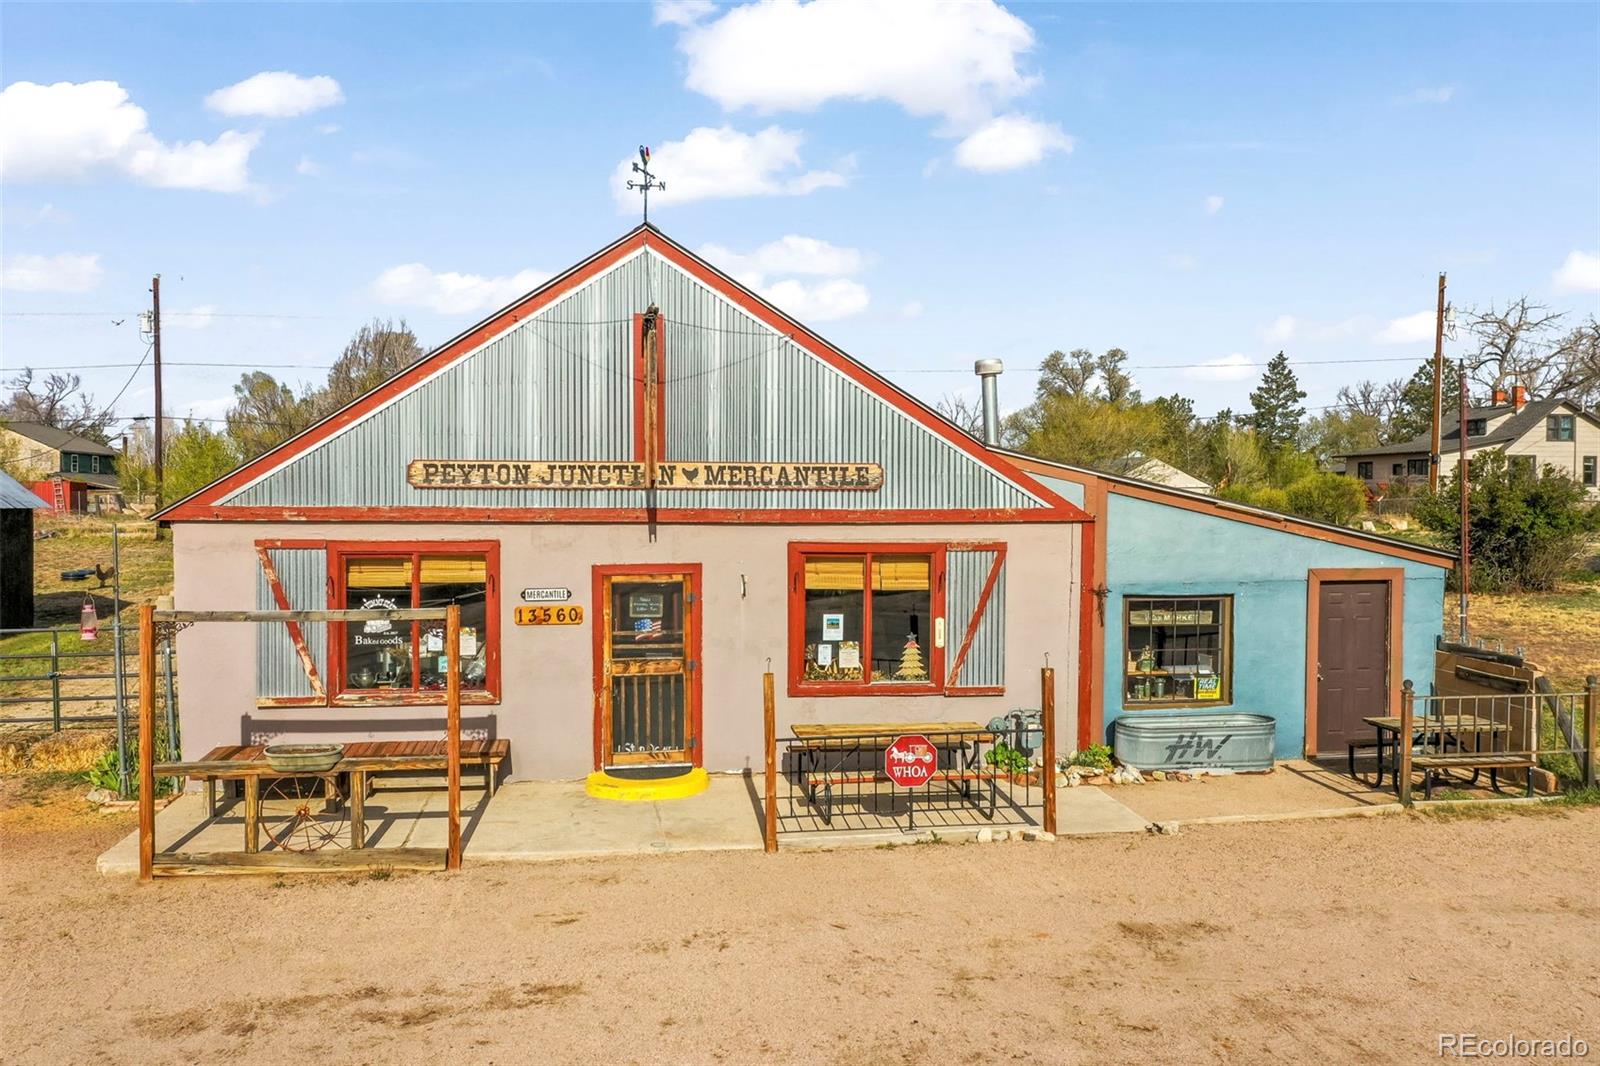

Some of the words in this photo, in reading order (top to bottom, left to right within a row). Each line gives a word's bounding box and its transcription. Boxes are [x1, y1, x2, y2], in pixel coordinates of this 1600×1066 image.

[422, 463, 531, 485] PEYTON
[540, 463, 677, 486] JUNCTIN
[704, 465, 870, 487] MERCANTILE
[526, 590, 566, 599] MERCANTILE
[518, 608, 578, 623] 13560
[1163, 613, 1199, 621] MRKET
[892, 765, 928, 778] WHOA
